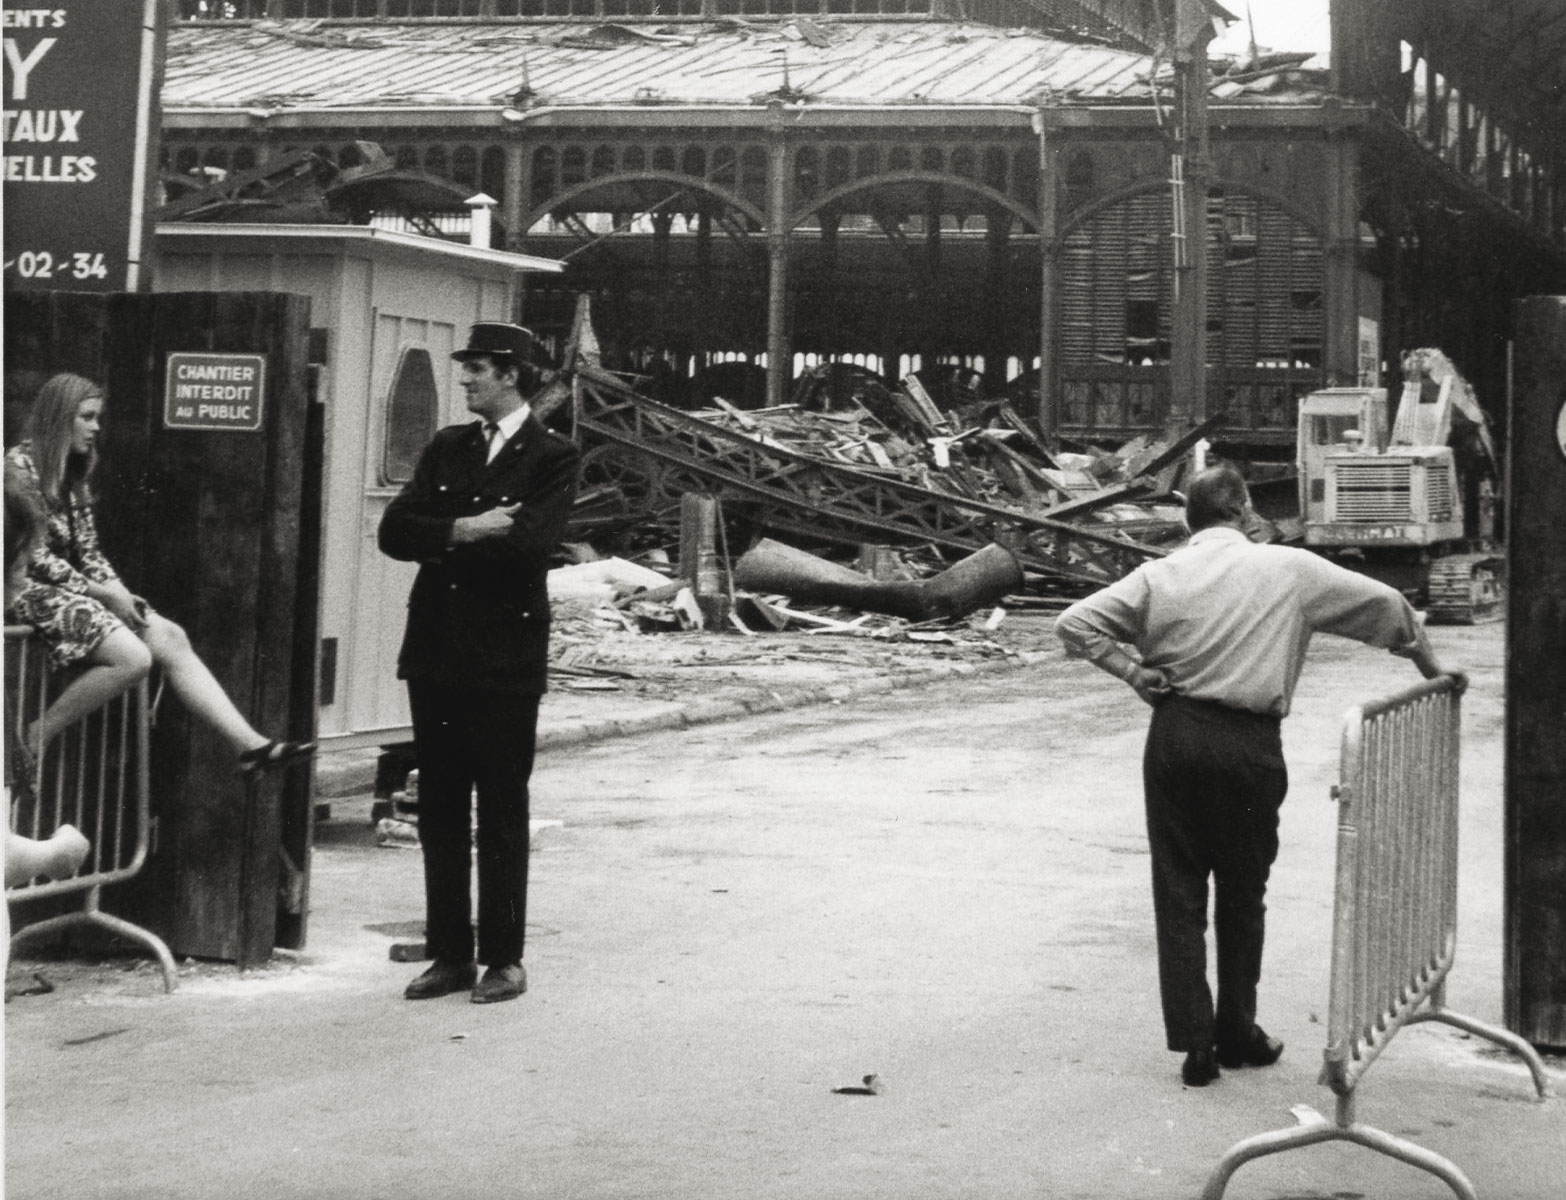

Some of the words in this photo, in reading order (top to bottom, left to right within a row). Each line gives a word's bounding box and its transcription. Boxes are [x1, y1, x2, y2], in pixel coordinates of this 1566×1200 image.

[3, 9, 67, 28] ENTS
[3, 37, 58, 100] Y
[3, 110, 84, 142] TAUX
[177, 364, 255, 381] CHANTIER
[176, 384, 254, 400] INTERDIT
[175, 406, 194, 418] AU
[198, 404, 252, 420] PUBLIC
